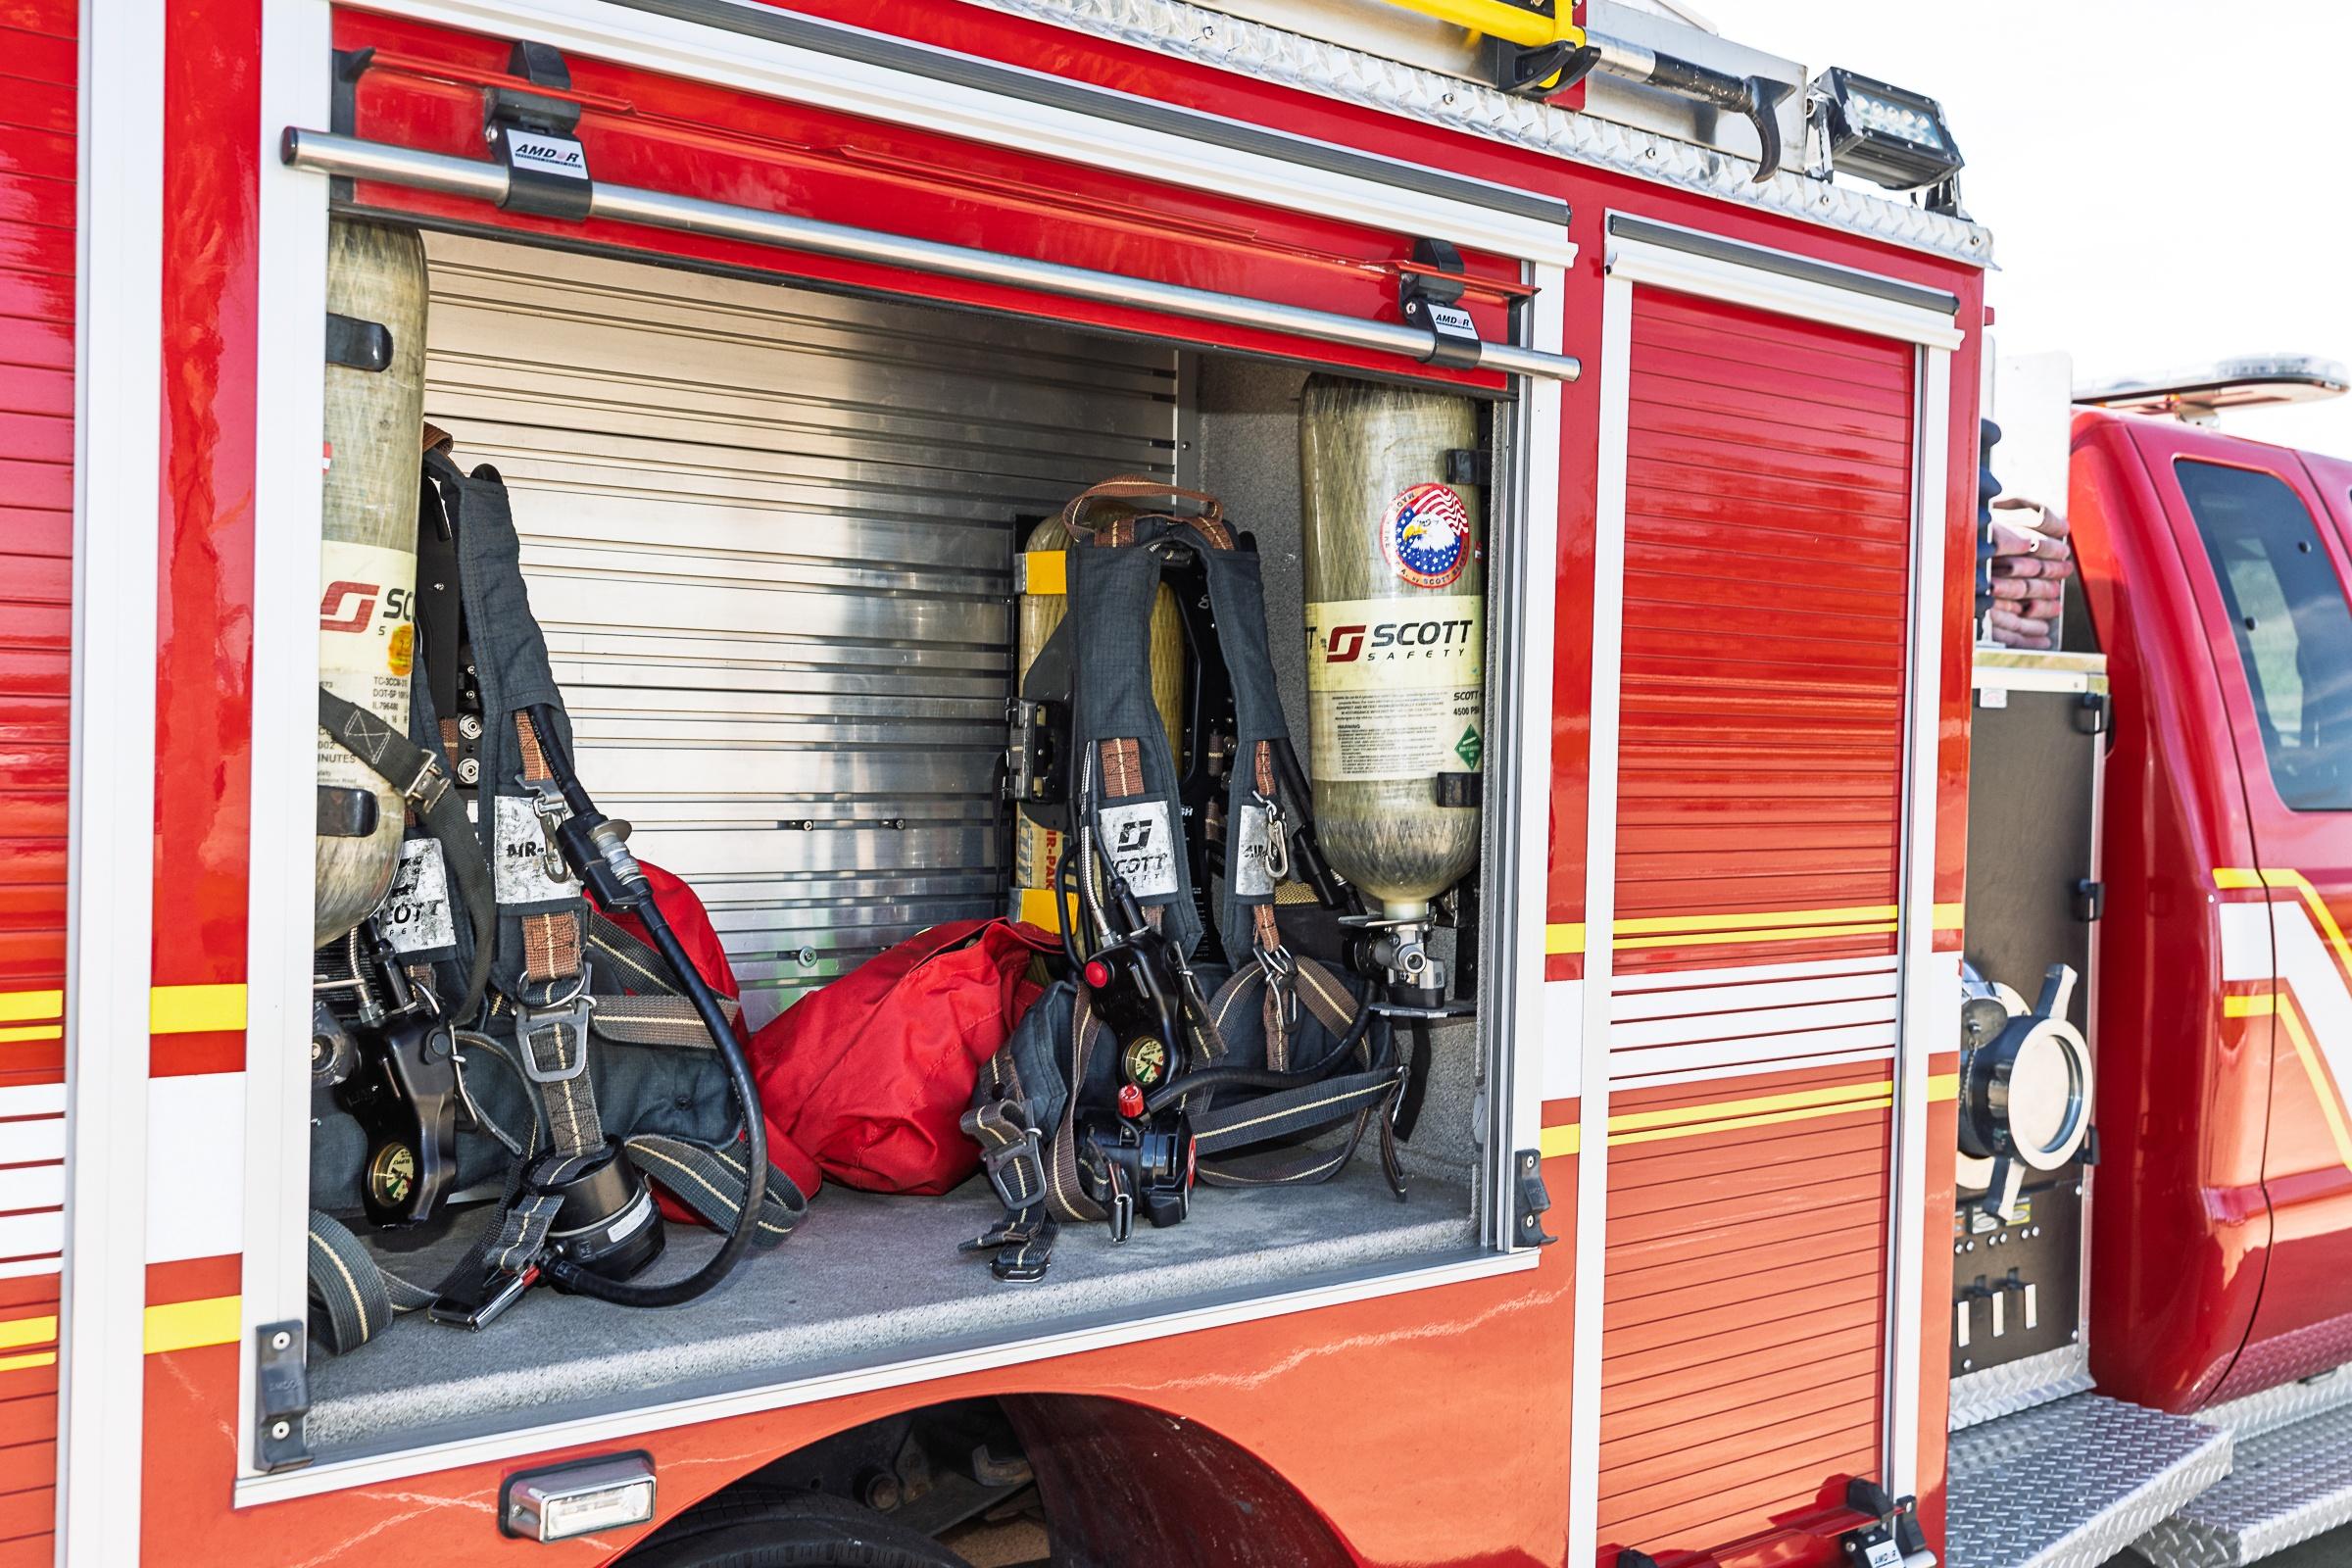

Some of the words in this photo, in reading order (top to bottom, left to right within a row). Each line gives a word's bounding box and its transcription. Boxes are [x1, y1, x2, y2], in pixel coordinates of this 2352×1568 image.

[1371, 619, 1473, 648] SCOTT
[1367, 647, 1465, 662] SAFETY
[1453, 690, 1479, 702] SCOTT
[1453, 707, 1469, 716] 4500
[318, 754, 356, 763] INUTES
[1046, 830, 1057, 890] IR-PAK
[1111, 853, 1168, 874] COTT
